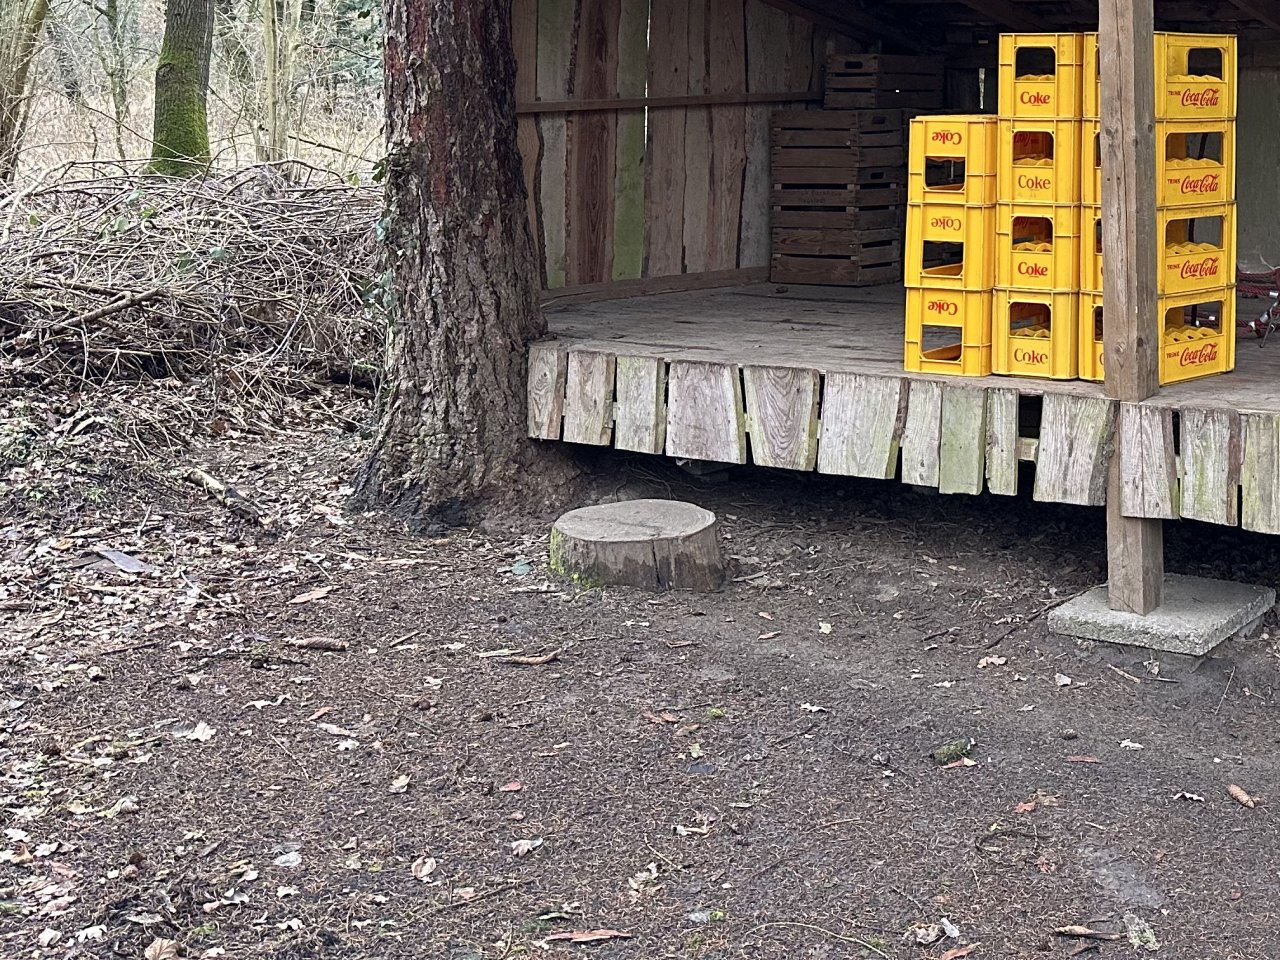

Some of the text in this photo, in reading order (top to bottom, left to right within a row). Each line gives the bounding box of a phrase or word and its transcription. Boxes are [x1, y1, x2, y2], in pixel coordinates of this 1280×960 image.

[1020, 91, 1050, 105] Coke
[932, 131, 962, 145] Coke
[1018, 174, 1051, 189] Coke
[931, 217, 962, 231] Coke
[1017, 261, 1048, 276] Coke
[928, 301, 958, 316] Coke
[1014, 349, 1049, 364] Coke
